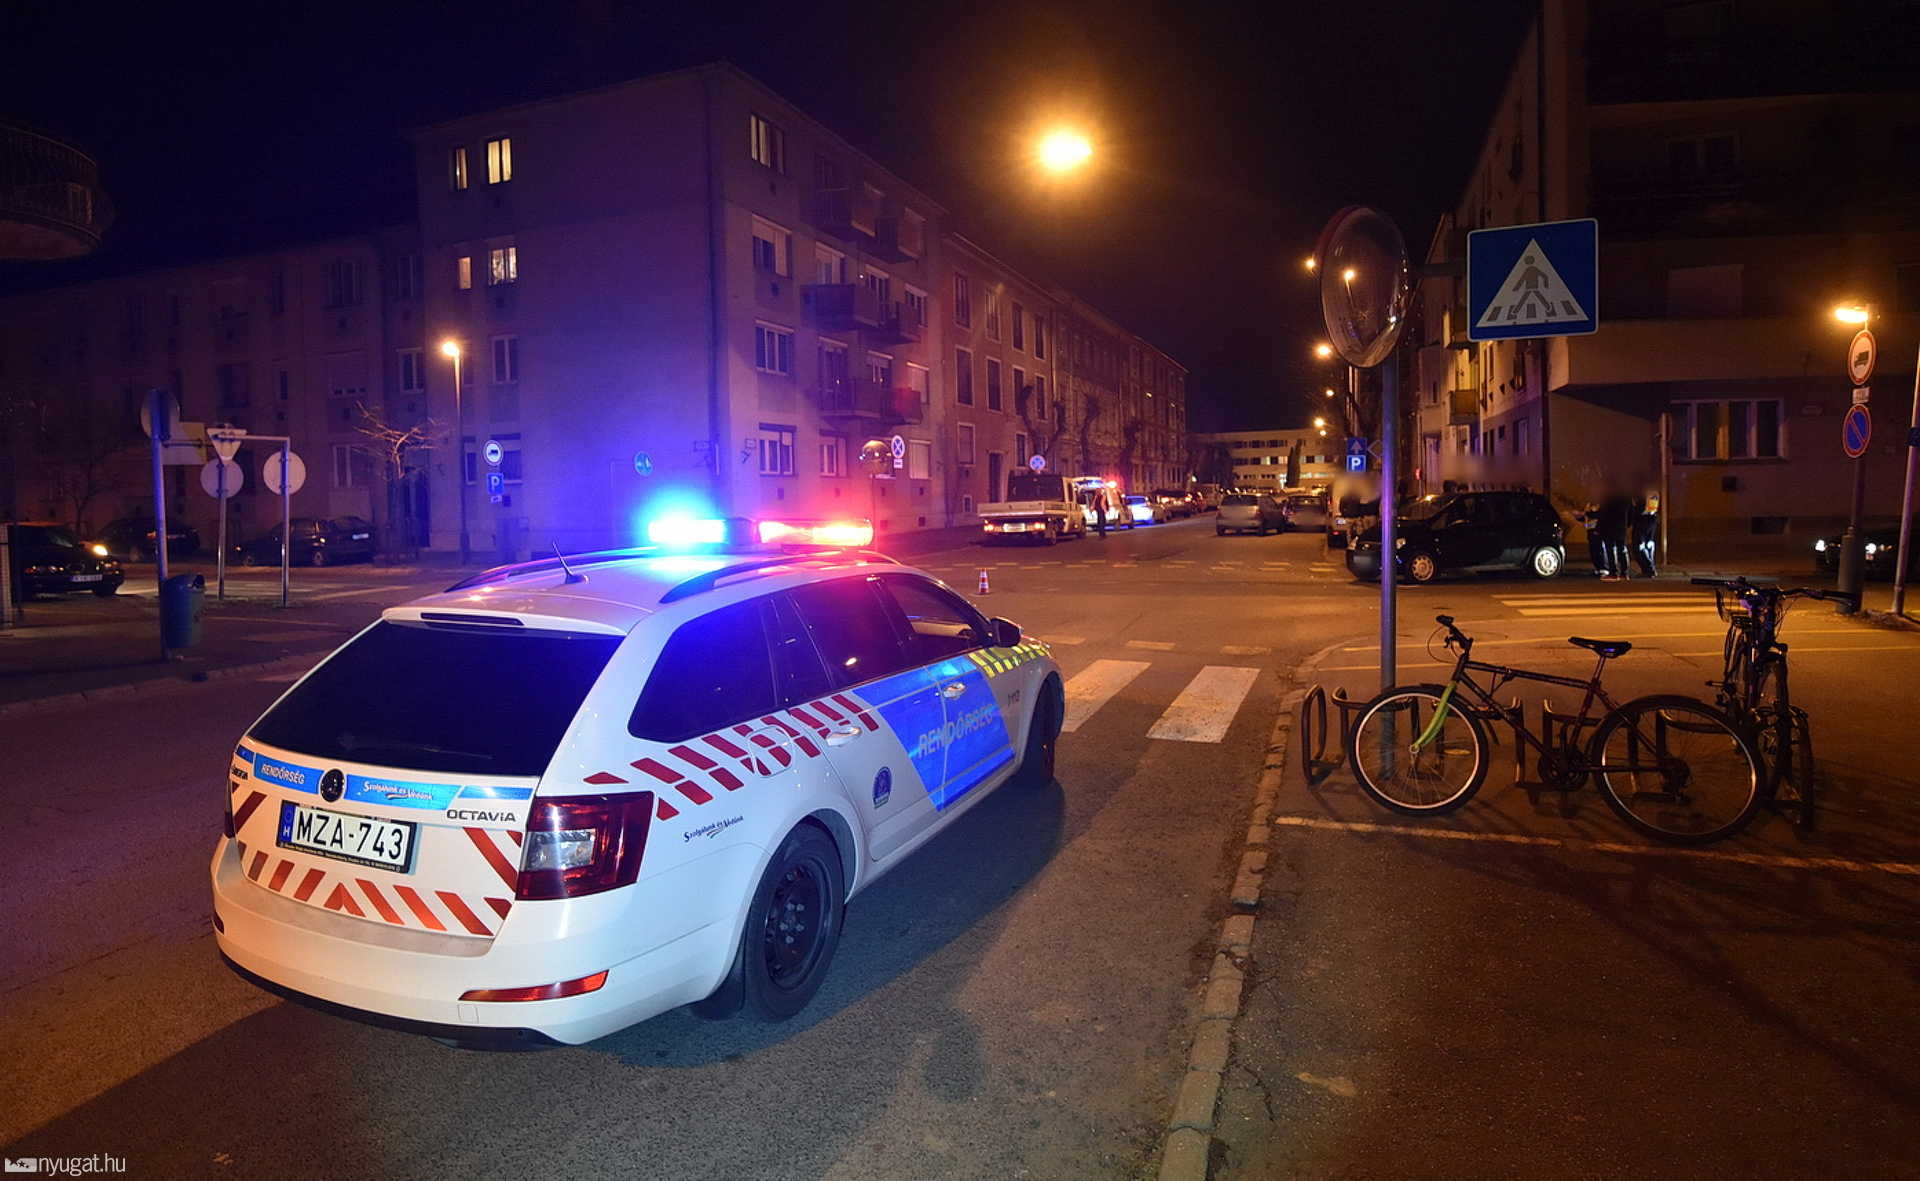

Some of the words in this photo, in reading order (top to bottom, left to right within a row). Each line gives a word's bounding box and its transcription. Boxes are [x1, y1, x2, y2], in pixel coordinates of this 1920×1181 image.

[1352, 457, 1361, 471] P
[491, 475, 500, 491] P
[282, 826, 291, 837] H
[296, 810, 404, 860] MZA-743
